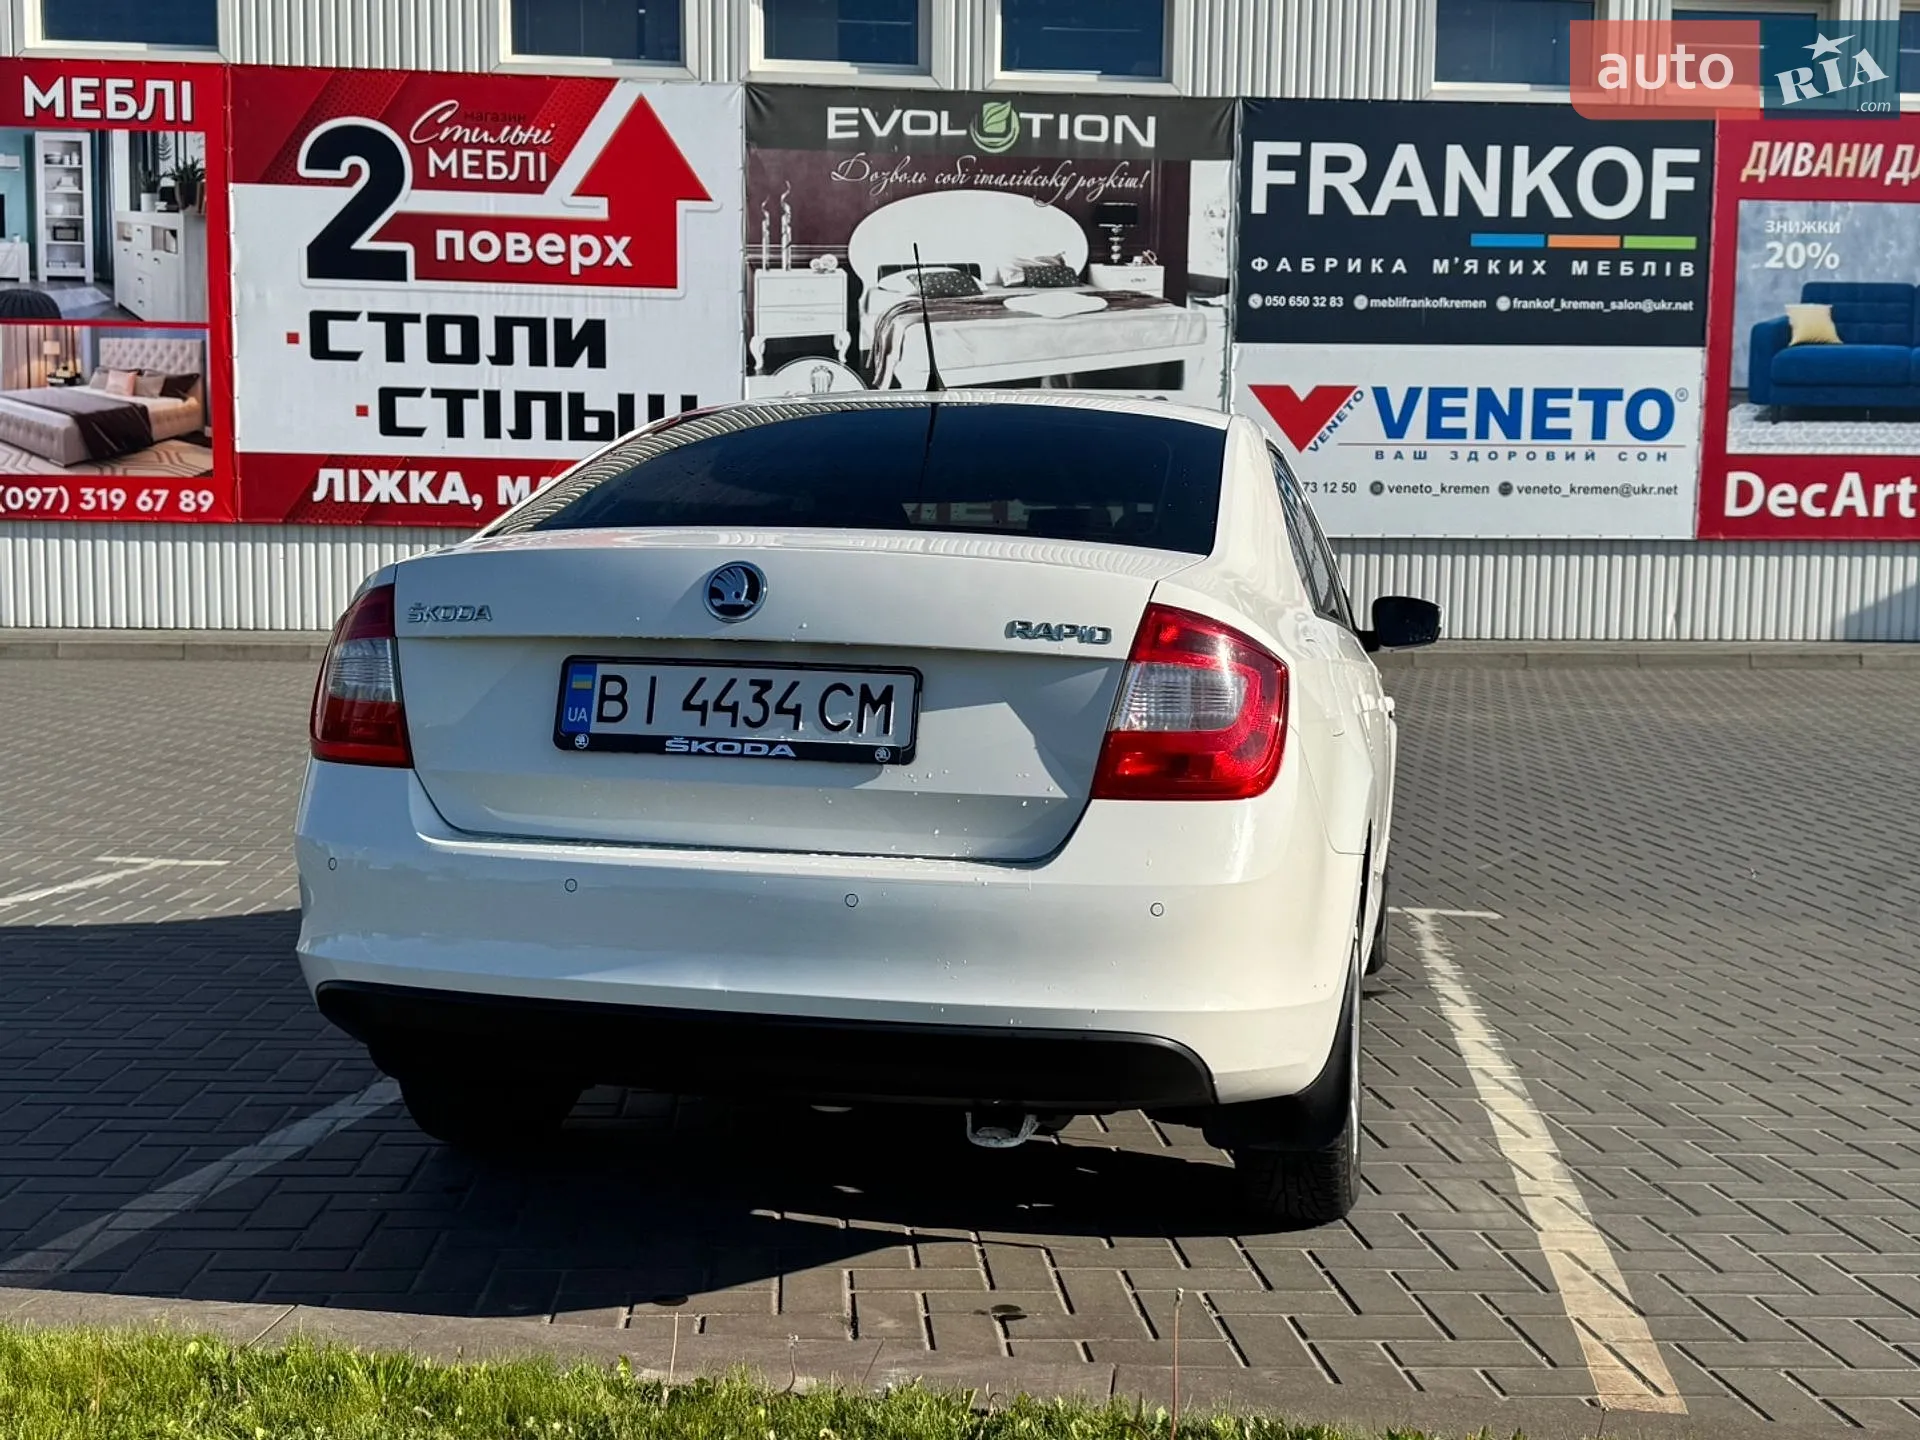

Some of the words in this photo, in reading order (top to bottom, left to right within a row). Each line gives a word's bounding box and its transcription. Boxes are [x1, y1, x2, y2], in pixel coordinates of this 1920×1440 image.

[23, 74, 193, 122] МЕБЛІ
[410, 99, 556, 146] Стильні
[463, 110, 527, 123] магазин
[428, 147, 547, 182] МЕБЛІ
[830, 152, 928, 196] Дозволь
[934, 155, 977, 185] собі
[1739, 140, 1884, 184] ДИВАНИ
[1249, 141, 1700, 220] FRANKOF
[303, 123, 410, 283] 2
[435, 227, 632, 276] поверх
[1250, 257, 1409, 275] ФАБРИКА
[1571, 261, 1696, 278] МЕБЛІВ
[1764, 241, 1840, 269] 20%
[1265, 295, 1287, 308] 050
[1289, 295, 1311, 308] 650
[1312, 295, 1328, 308] 32
[1329, 295, 1345, 308] 83
[308, 309, 608, 369] СТОЛИ
[1308, 389, 1364, 452] VENETO
[1371, 386, 1676, 442] VENETO
[1375, 450, 1428, 461] ВАШ
[1450, 449, 1596, 462] ЗДОРОВИЙ
[1618, 451, 1668, 463] СОН
[78, 487, 127, 511] 319
[135, 488, 170, 512] 67
[178, 489, 215, 513] 89
[313, 467, 484, 511] ЛІЖКА,
[1323, 481, 1338, 494] 12
[1341, 482, 1357, 494] 50
[1387, 483, 1490, 497] veneto_kremen
[1517, 483, 1678, 498] veneto_kremen@ukr.net
[1724, 471, 1918, 518] DecArt
[407, 602, 493, 624] ŠKODA
[1004, 620, 1112, 645] RAPID
[567, 707, 588, 723] UA
[596, 674, 658, 725] BI
[682, 676, 803, 731] 4434
[818, 682, 896, 735] CM
[664, 736, 797, 758] ŠKODA
